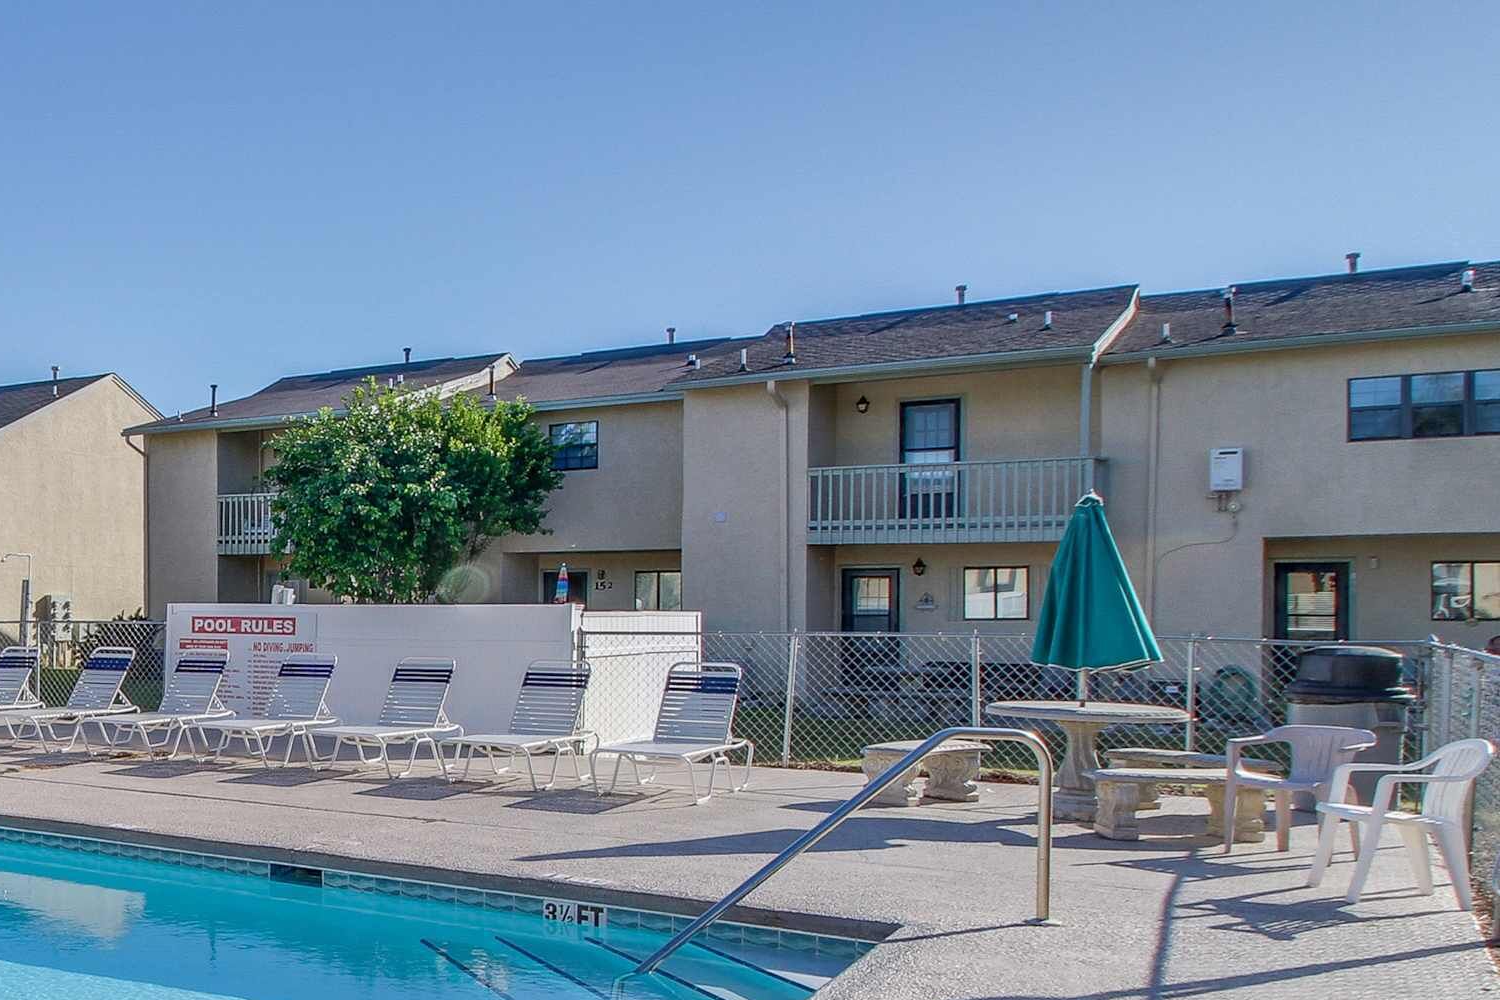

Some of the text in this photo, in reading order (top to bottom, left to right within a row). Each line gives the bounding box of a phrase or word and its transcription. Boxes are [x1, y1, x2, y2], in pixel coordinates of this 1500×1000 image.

[595, 581, 613, 591] 152
[194, 618, 294, 634] POOL RULES
[253, 641, 262, 652] NO
[577, 904, 605, 927] FT
